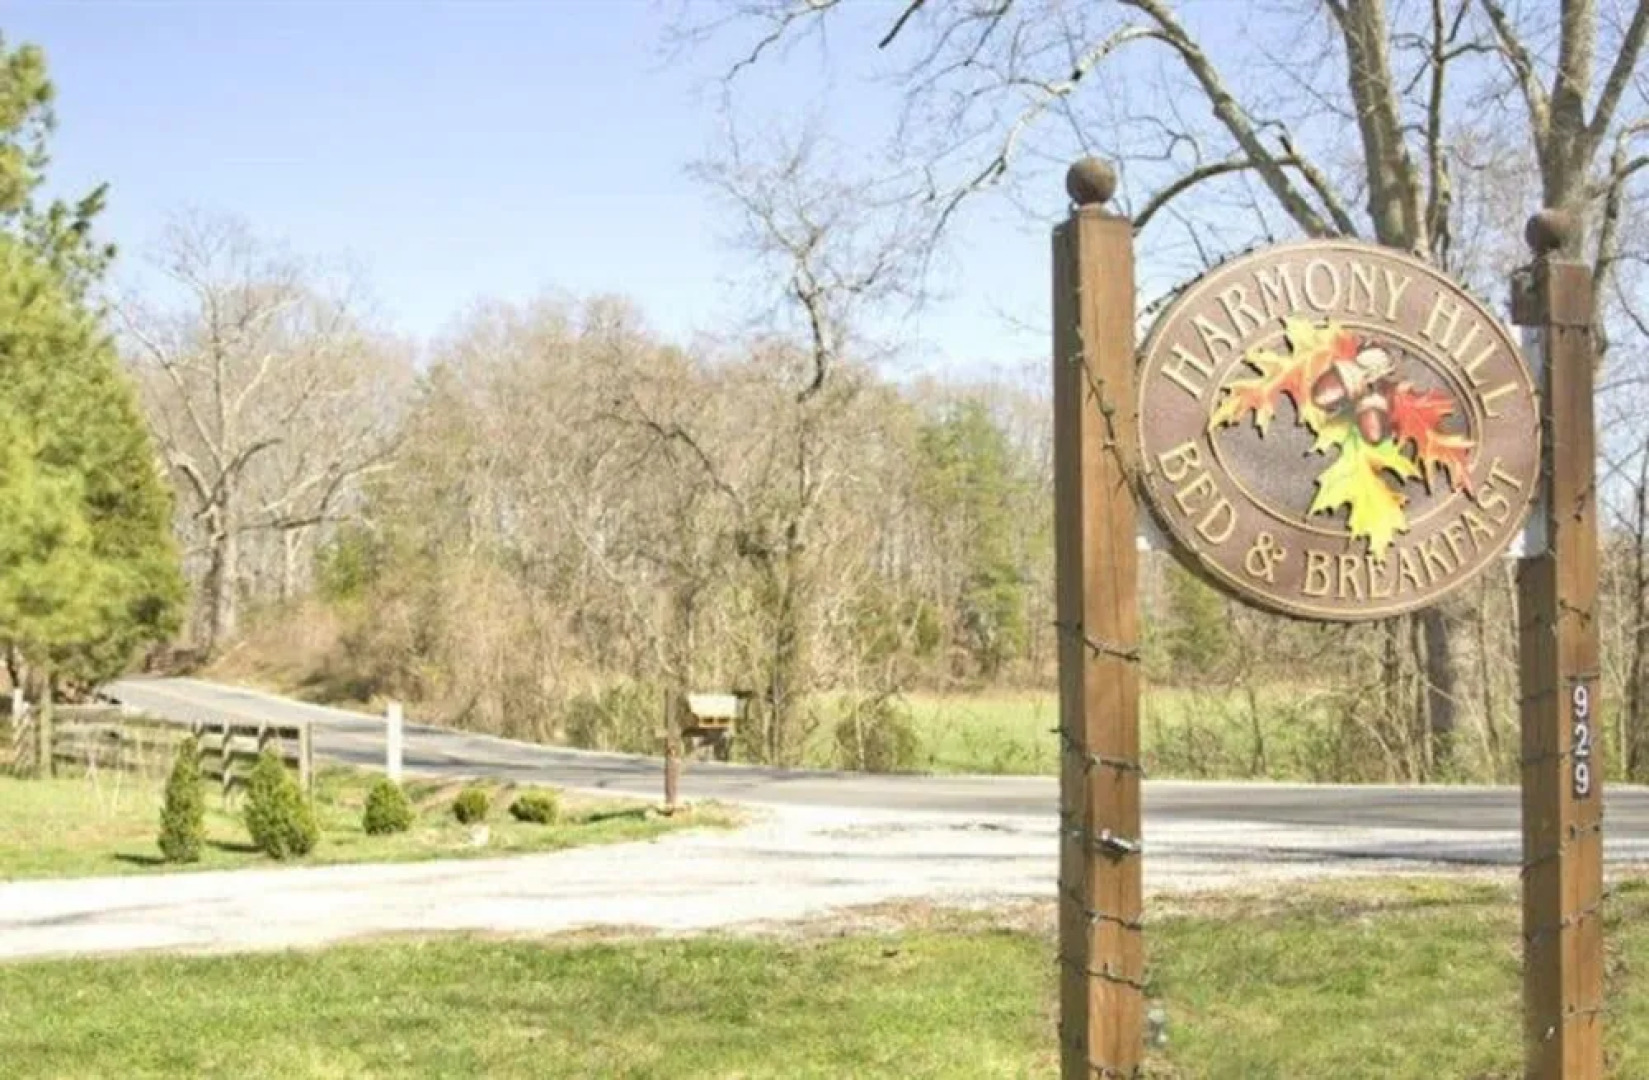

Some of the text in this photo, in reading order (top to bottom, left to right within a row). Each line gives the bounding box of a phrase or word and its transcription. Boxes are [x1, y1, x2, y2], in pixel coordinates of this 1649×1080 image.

[1160, 257, 1519, 420] HARMONY HILL
[1156, 441, 1524, 600] BED & BREAKFAST
[1573, 685, 1590, 794] 929
